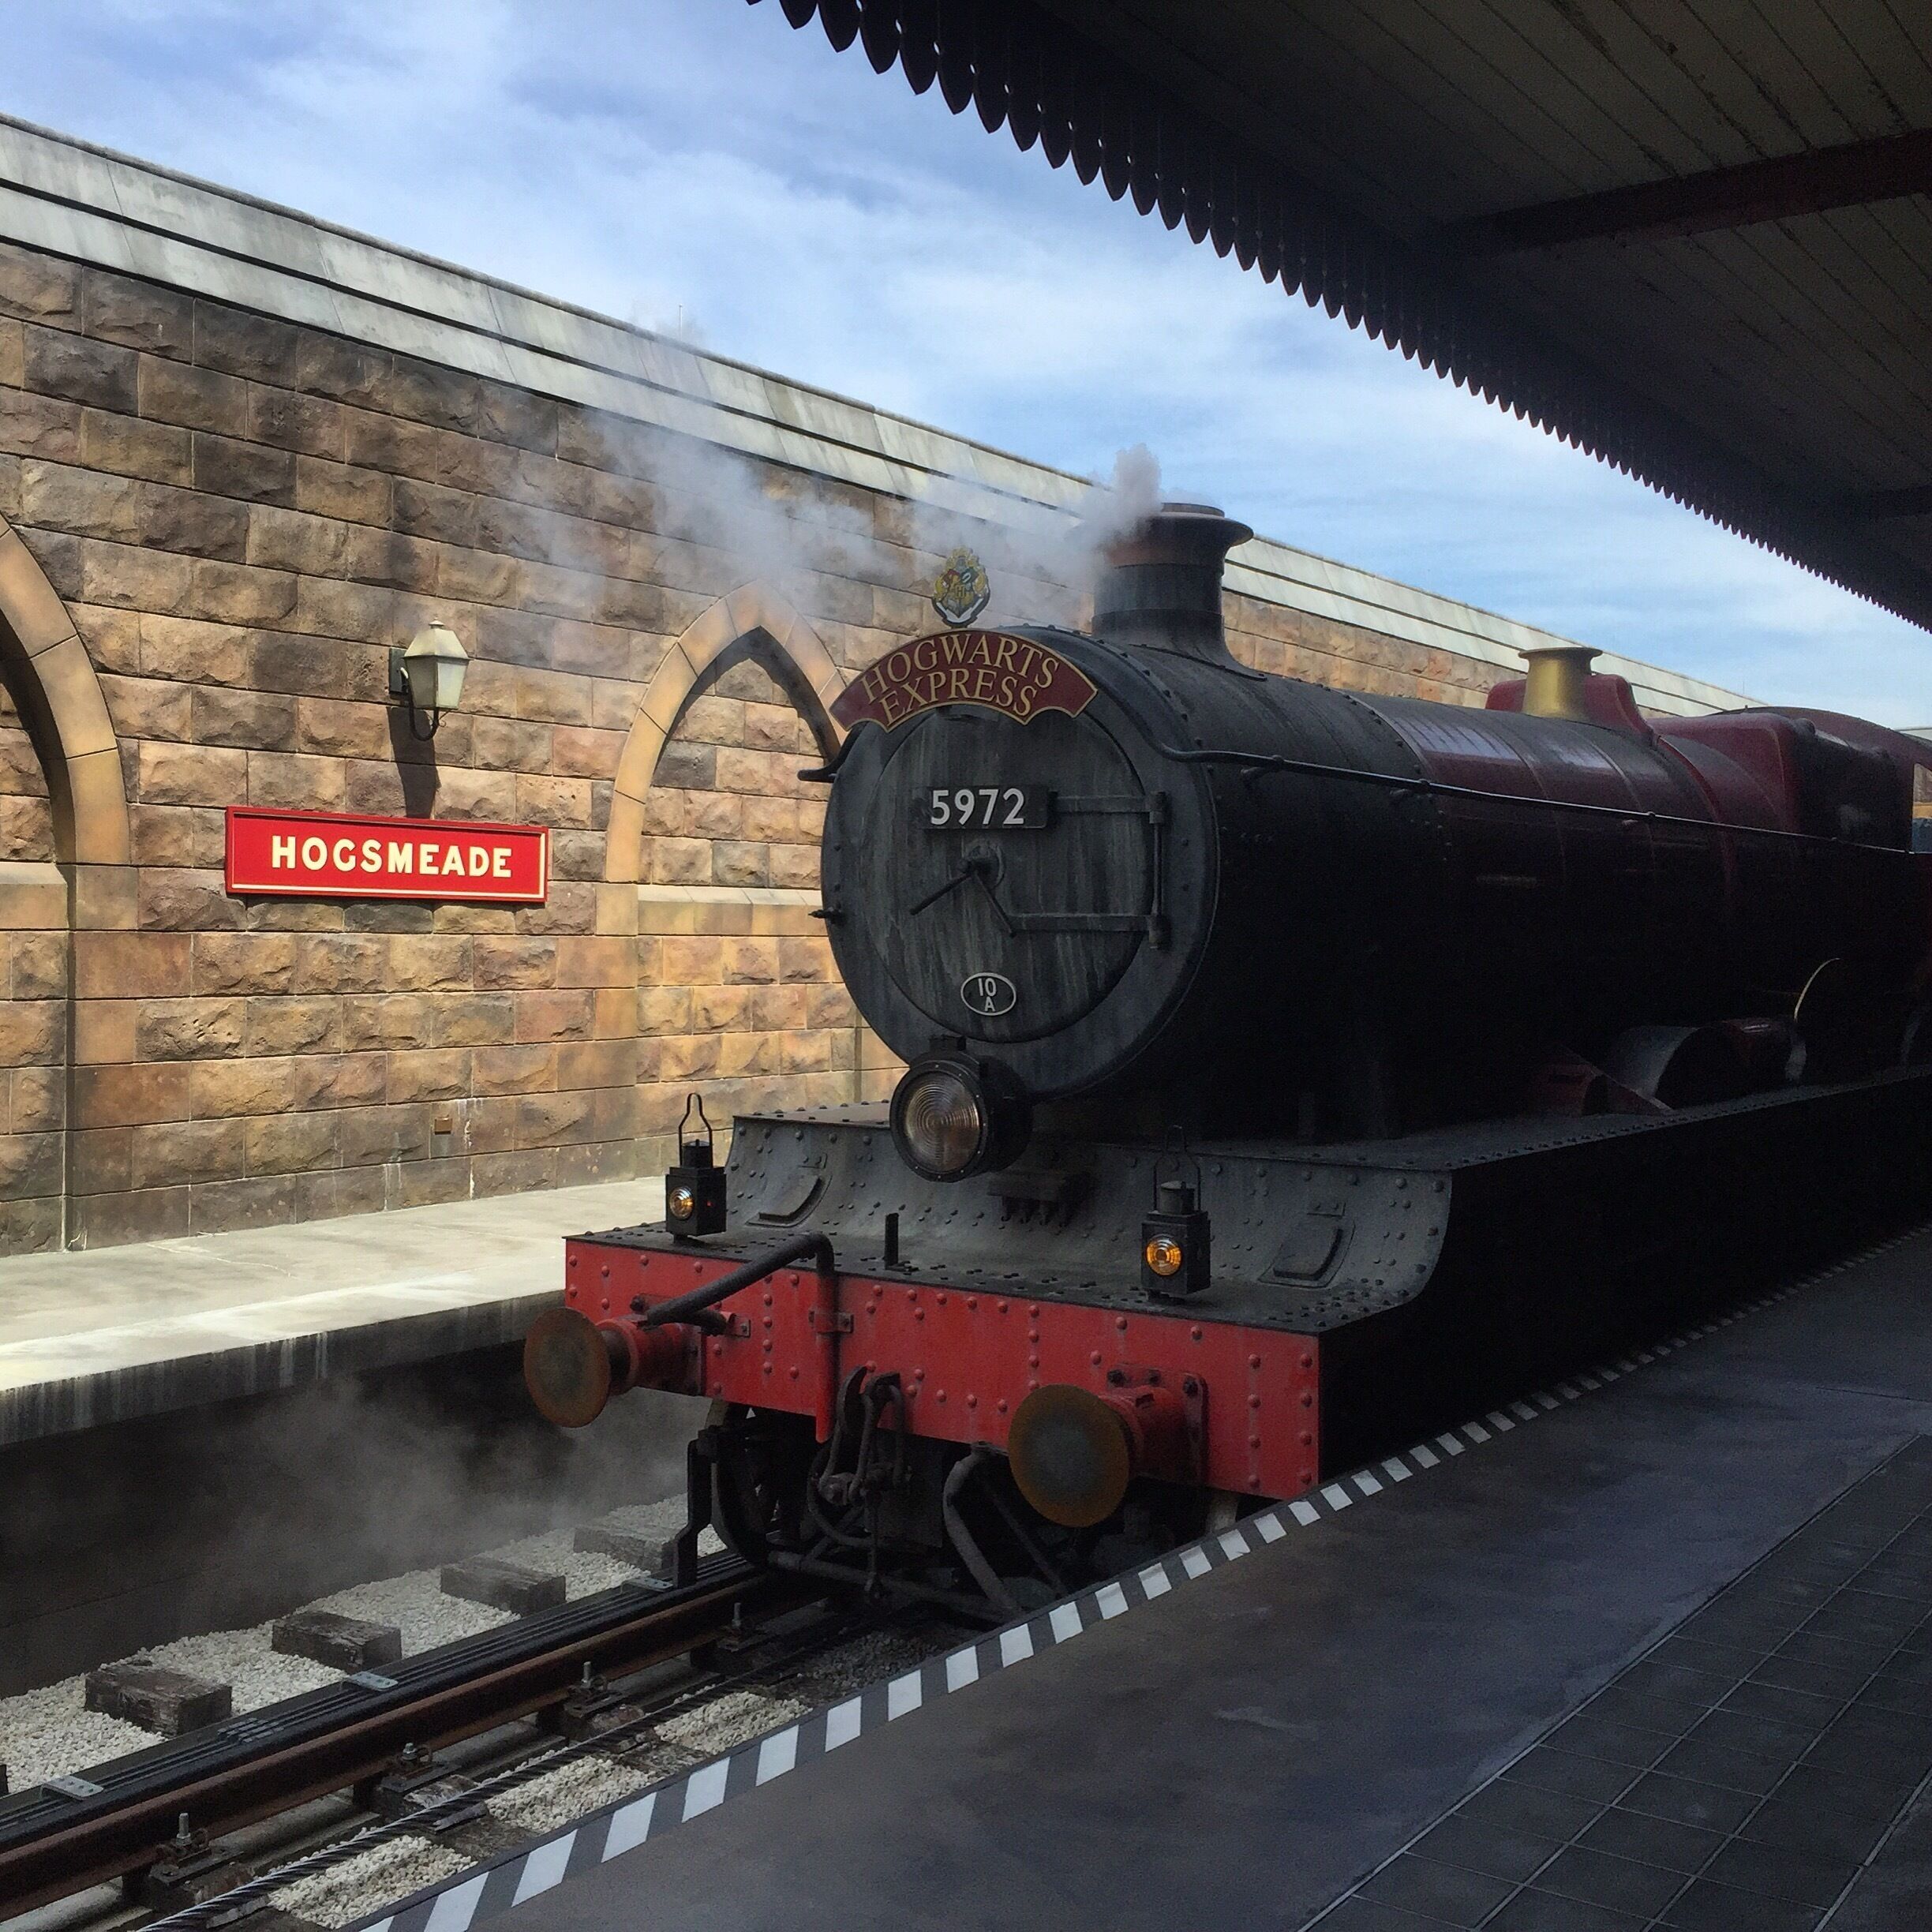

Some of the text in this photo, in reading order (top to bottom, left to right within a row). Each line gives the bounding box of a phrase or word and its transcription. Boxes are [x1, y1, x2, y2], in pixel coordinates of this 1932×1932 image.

[861, 634, 1060, 704] HOGWARTS
[878, 668, 1038, 725] EXPRESS
[930, 788, 1025, 826] 5972
[271, 834, 513, 878] HOGSMEADE
[978, 978, 997, 997] 10
[983, 996, 996, 1012] A
